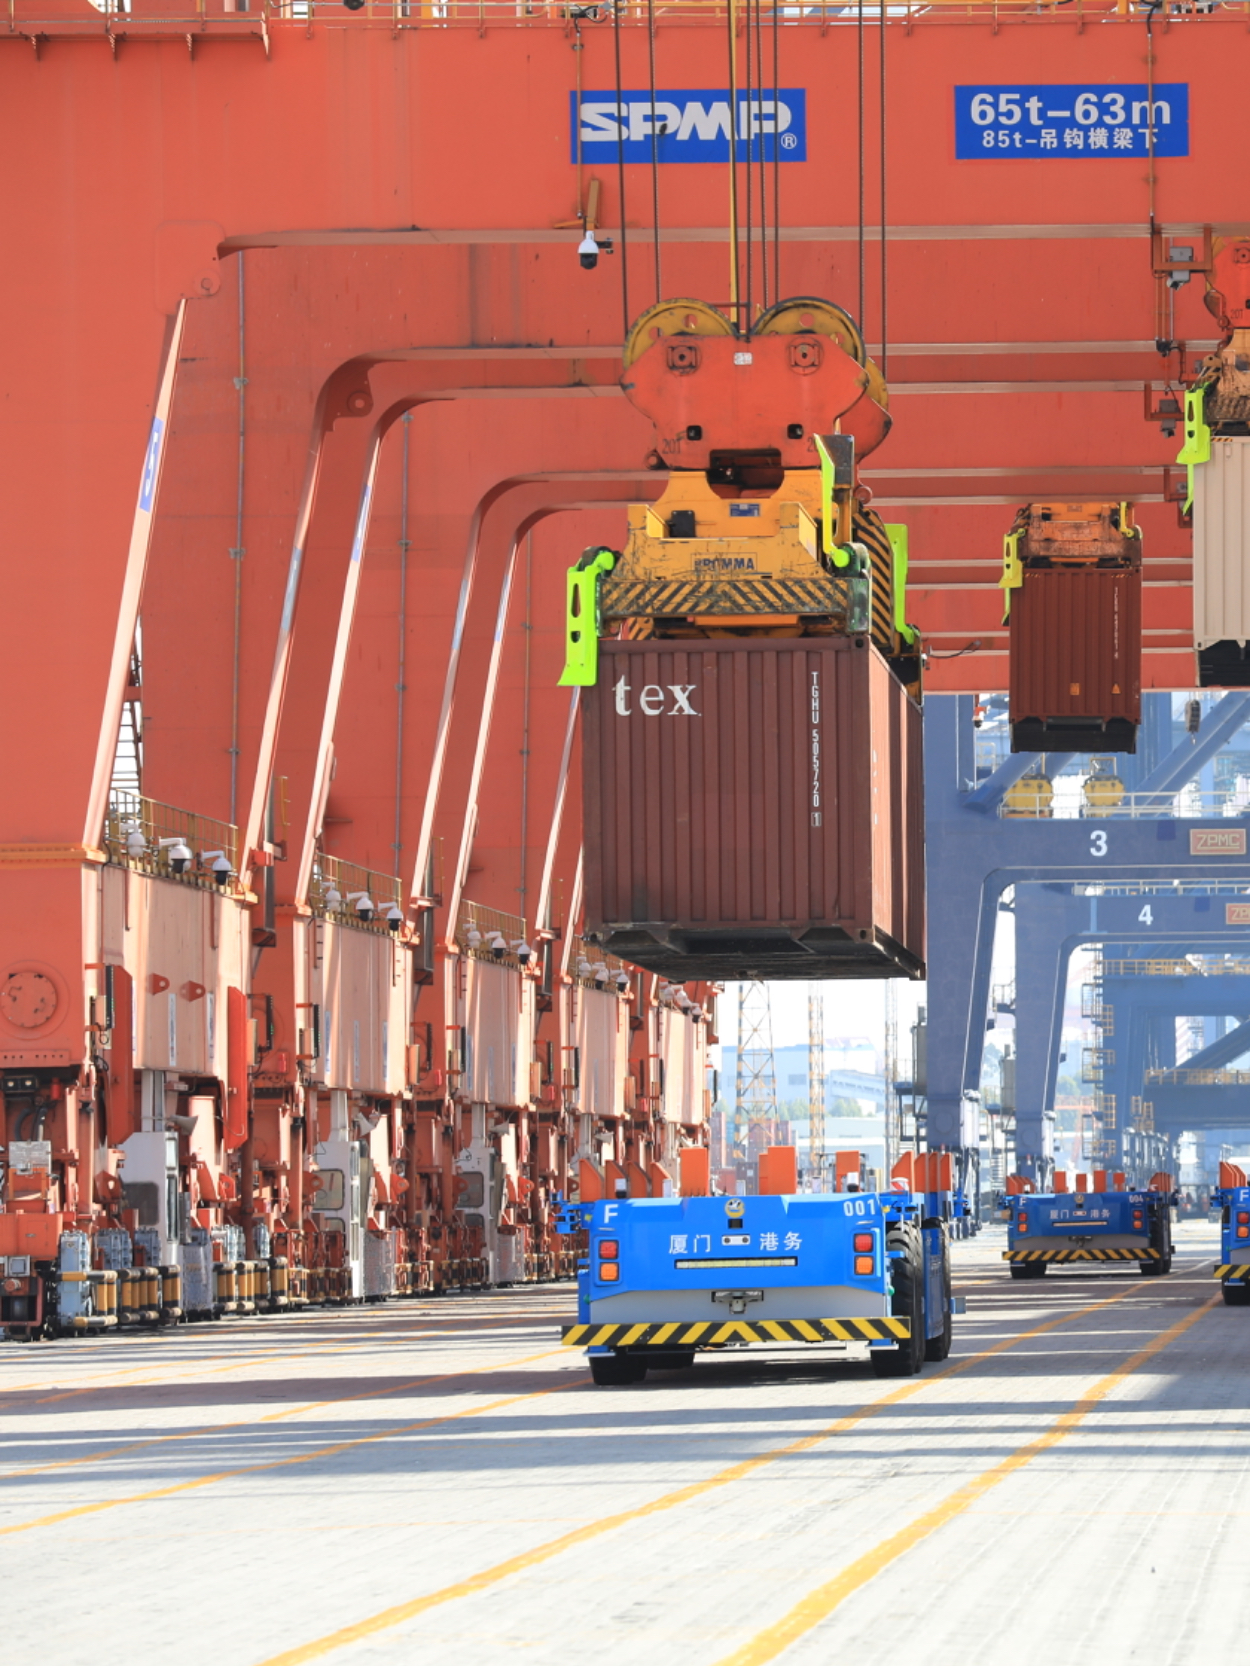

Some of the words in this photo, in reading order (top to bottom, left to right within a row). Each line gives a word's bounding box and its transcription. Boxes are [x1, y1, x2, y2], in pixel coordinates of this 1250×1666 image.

[580, 100, 792, 142] SPMP
[611, 674, 699, 716] tex
[811, 671, 820, 724] TGHU
[812, 728, 820, 807] 505720
[1090, 829, 1108, 857] 3
[1196, 834, 1240, 849] ZPMC
[1138, 904, 1153, 926] 4
[1018, 1198, 1027, 1206] F
[1240, 1189, 1249, 1202] F
[603, 1204, 618, 1223] F
[843, 1198, 876, 1217] 001
[668, 1234, 711, 1254] 厦门
[759, 1231, 803, 1251] 港务
